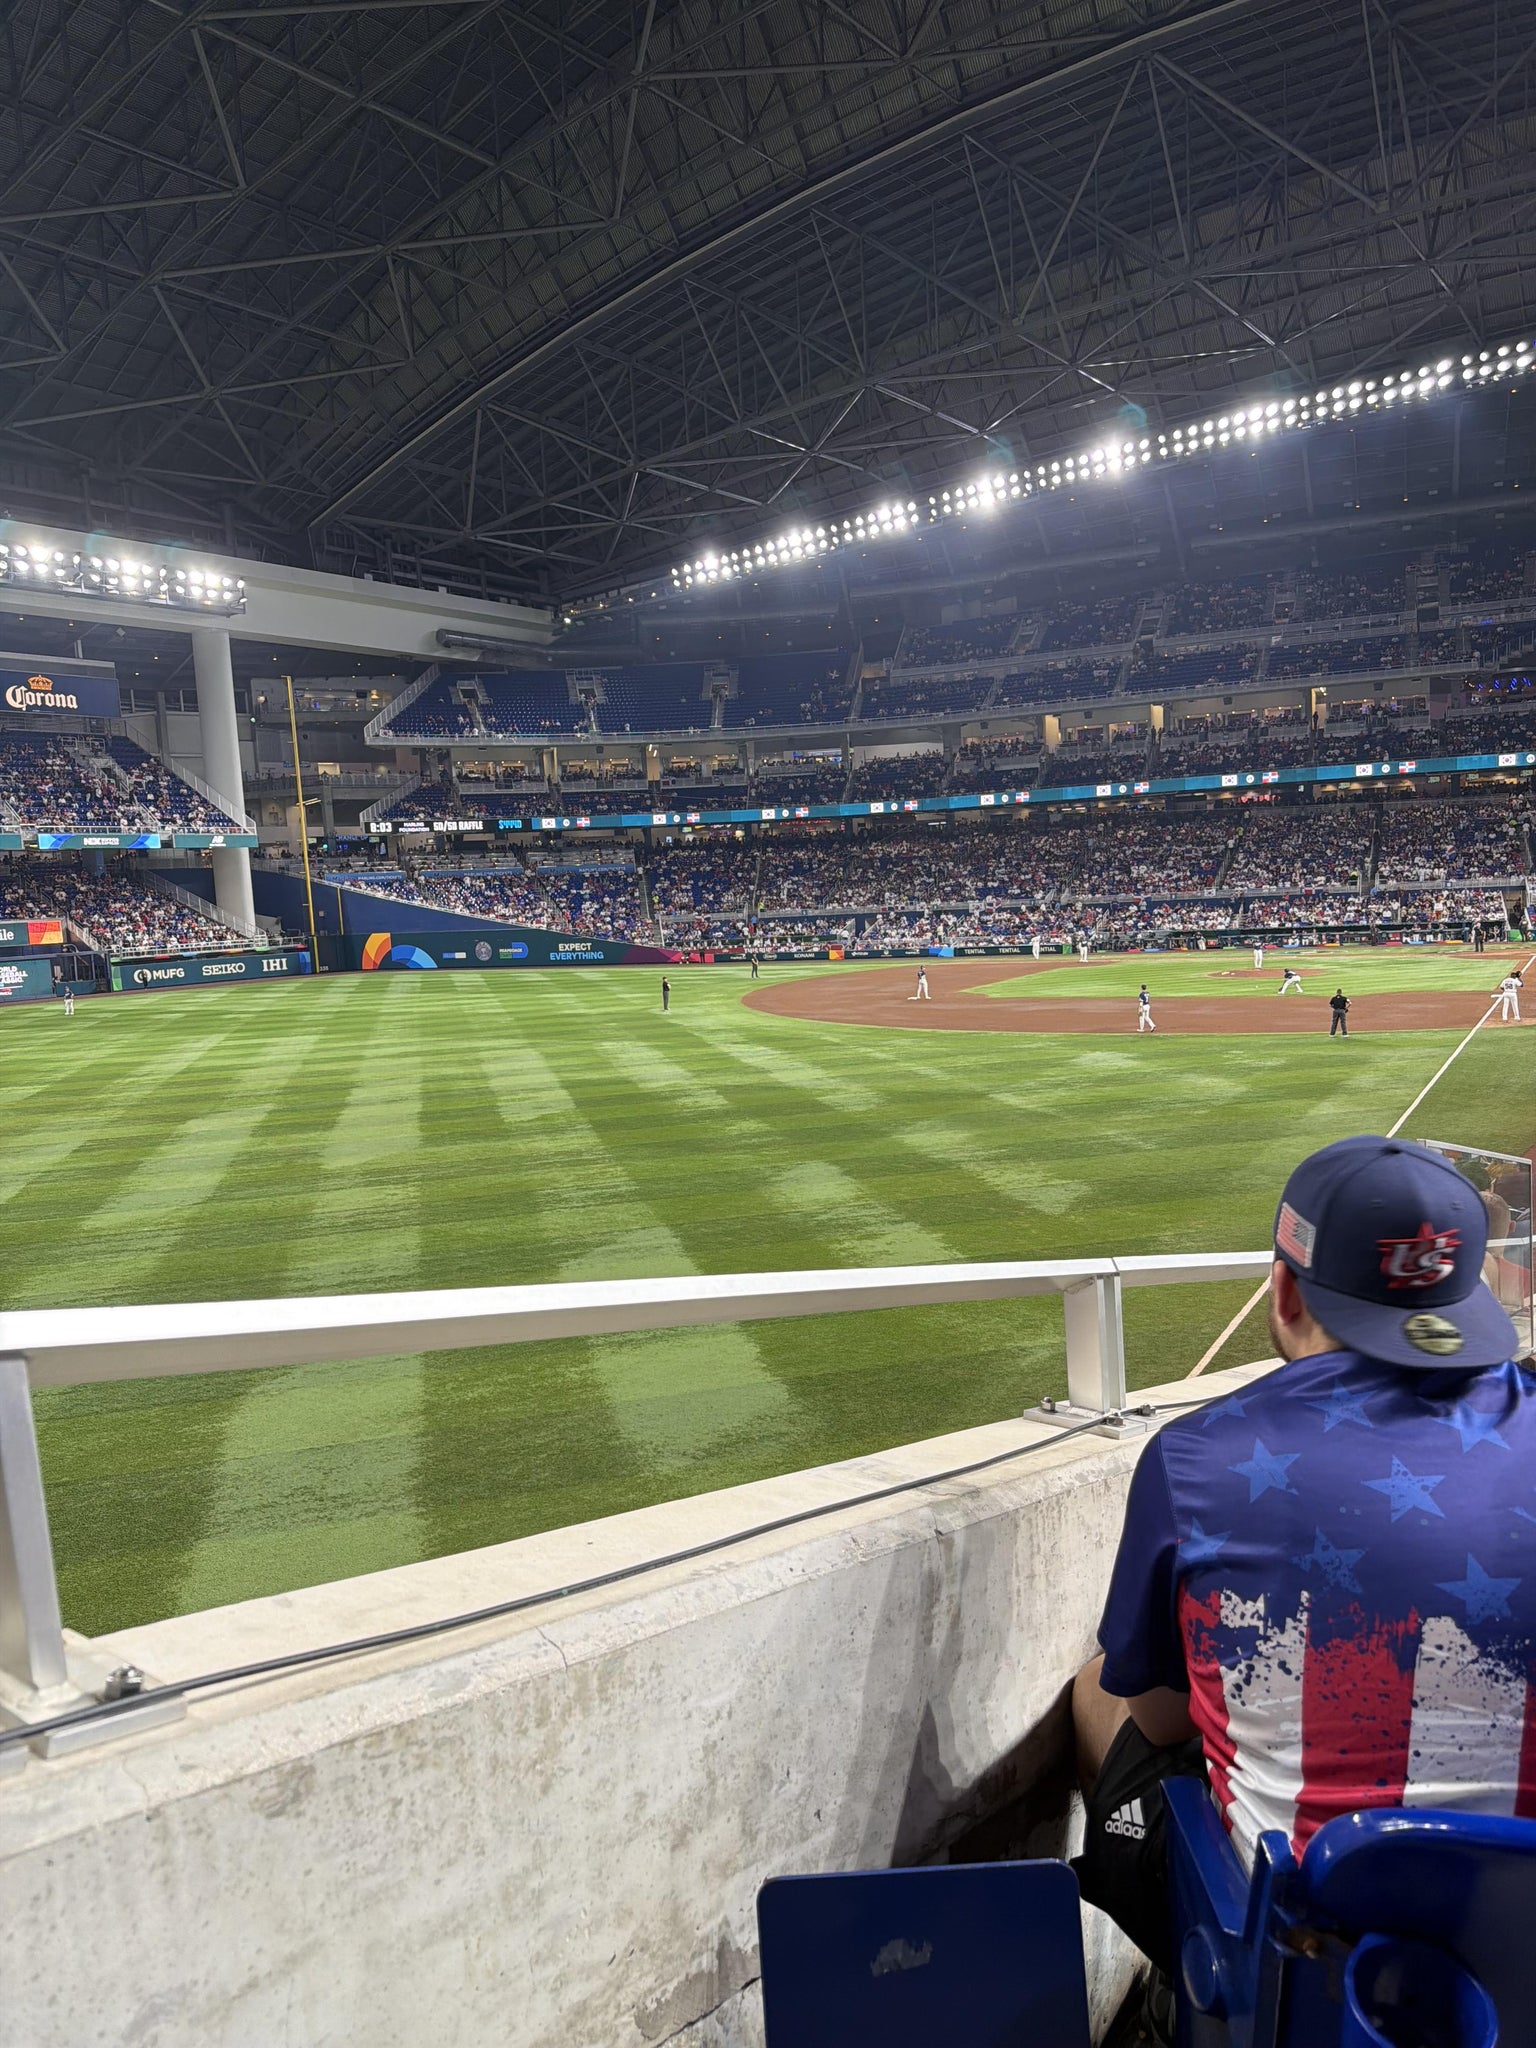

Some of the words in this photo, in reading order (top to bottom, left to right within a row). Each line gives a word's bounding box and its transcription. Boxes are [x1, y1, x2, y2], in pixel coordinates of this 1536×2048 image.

[5, 684, 79, 711] Corona
[433, 820, 457, 832] 50/50
[458, 820, 483, 830] RAFFLE
[558, 942, 593, 952] EXPECT
[998, 946, 1021, 954] TENTIAL
[549, 951, 604, 961] EVERYTHING
[202, 962, 246, 976] SEIKO
[262, 958, 288, 971] IHI
[153, 968, 185, 980] MUFG
[1105, 1819, 1146, 1840] adidas
